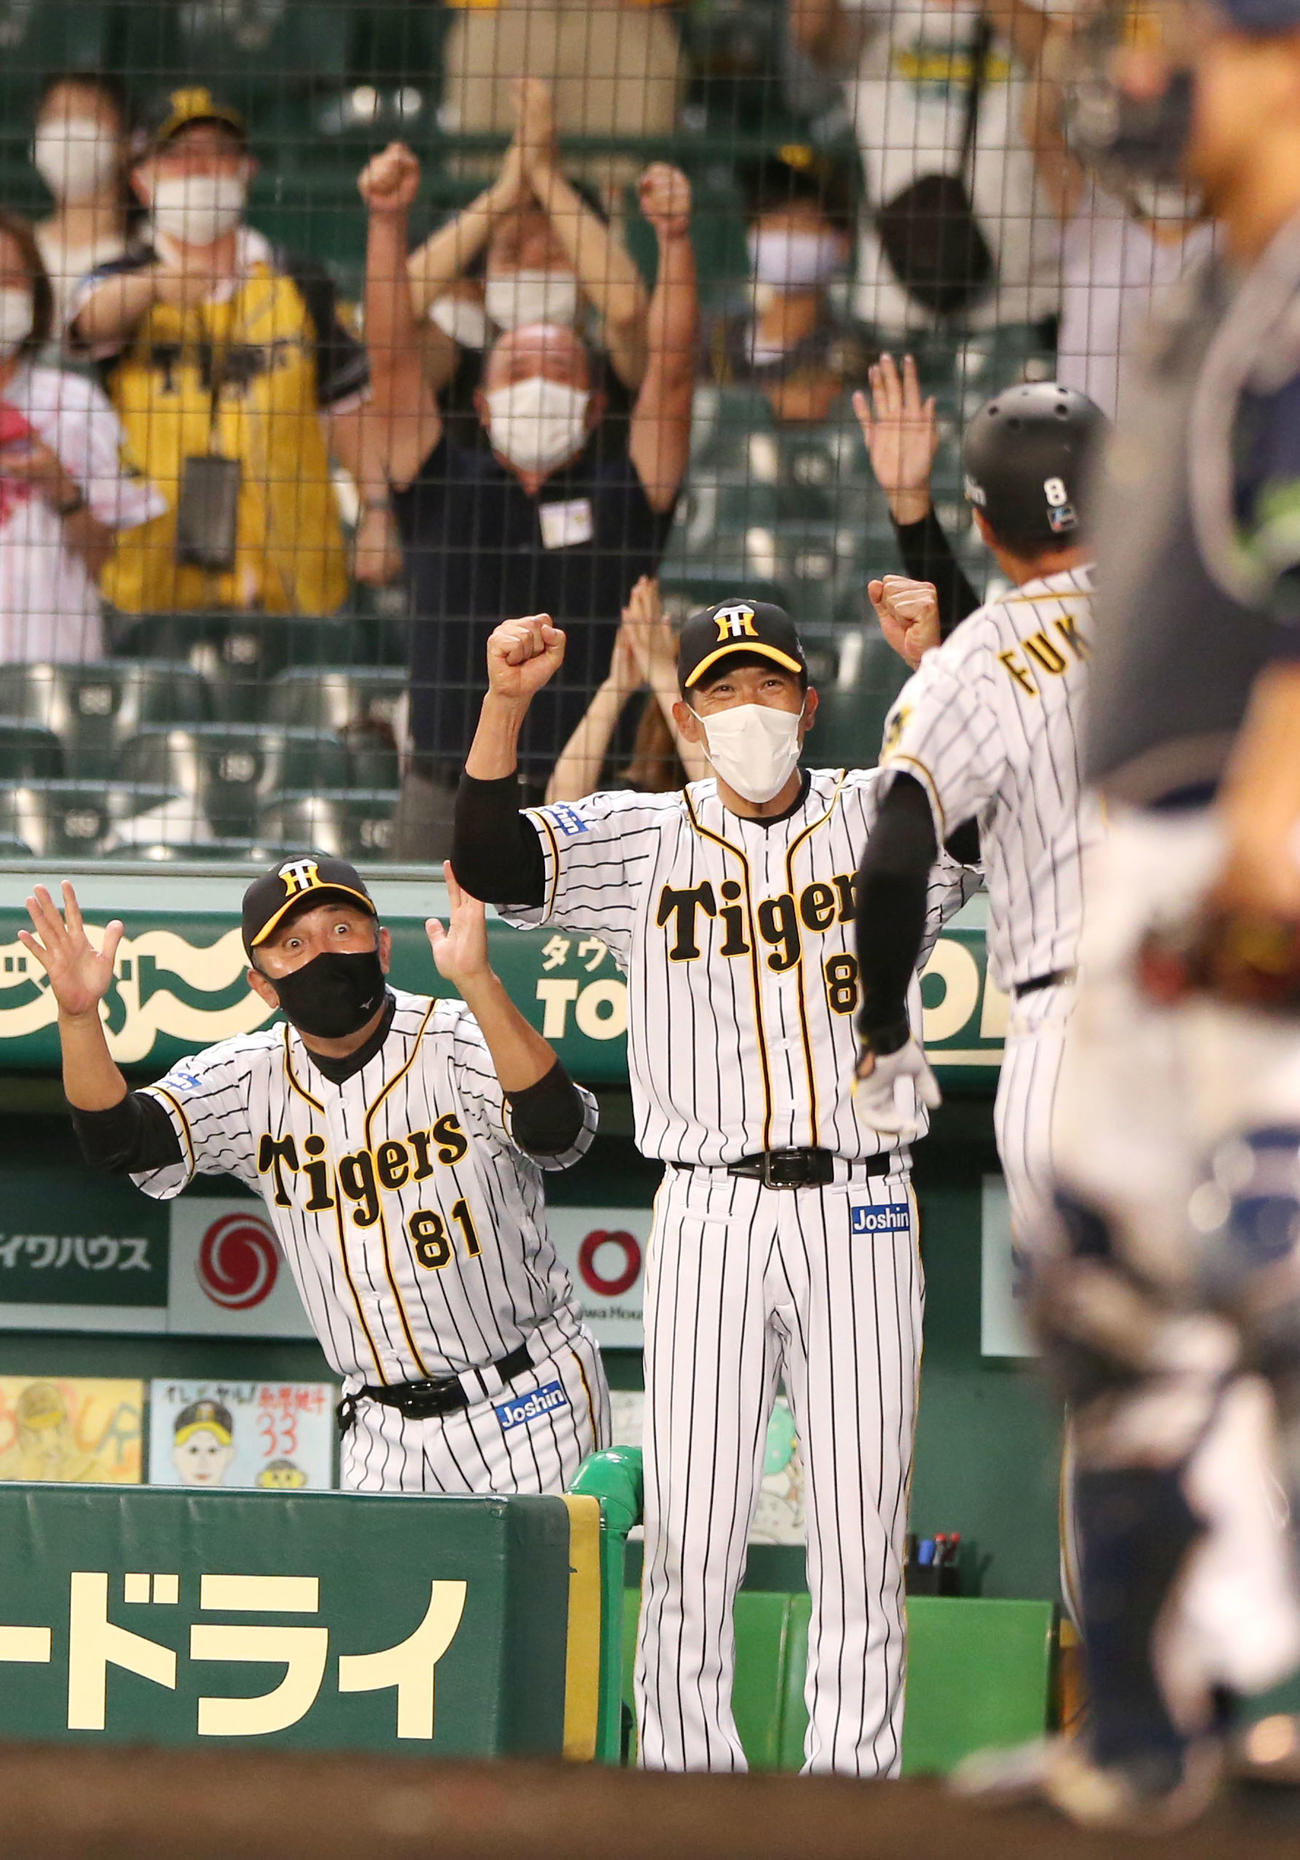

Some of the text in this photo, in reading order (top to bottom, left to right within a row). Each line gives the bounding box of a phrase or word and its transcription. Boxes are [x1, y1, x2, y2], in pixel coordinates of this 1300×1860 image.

[1043, 476, 1069, 508] 8
[997, 613, 1094, 695] FUK
[656, 871, 863, 974] Tiger
[536, 978, 629, 1041] TO
[257, 1111, 470, 1230] Tigers
[408, 1196, 484, 1271] 81
[853, 1206, 910, 1231] Joshin
[0, 1233, 151, 1271] イワハウス
[258, 1410, 298, 1457] 33
[502, 1388, 565, 1429] Joshin
